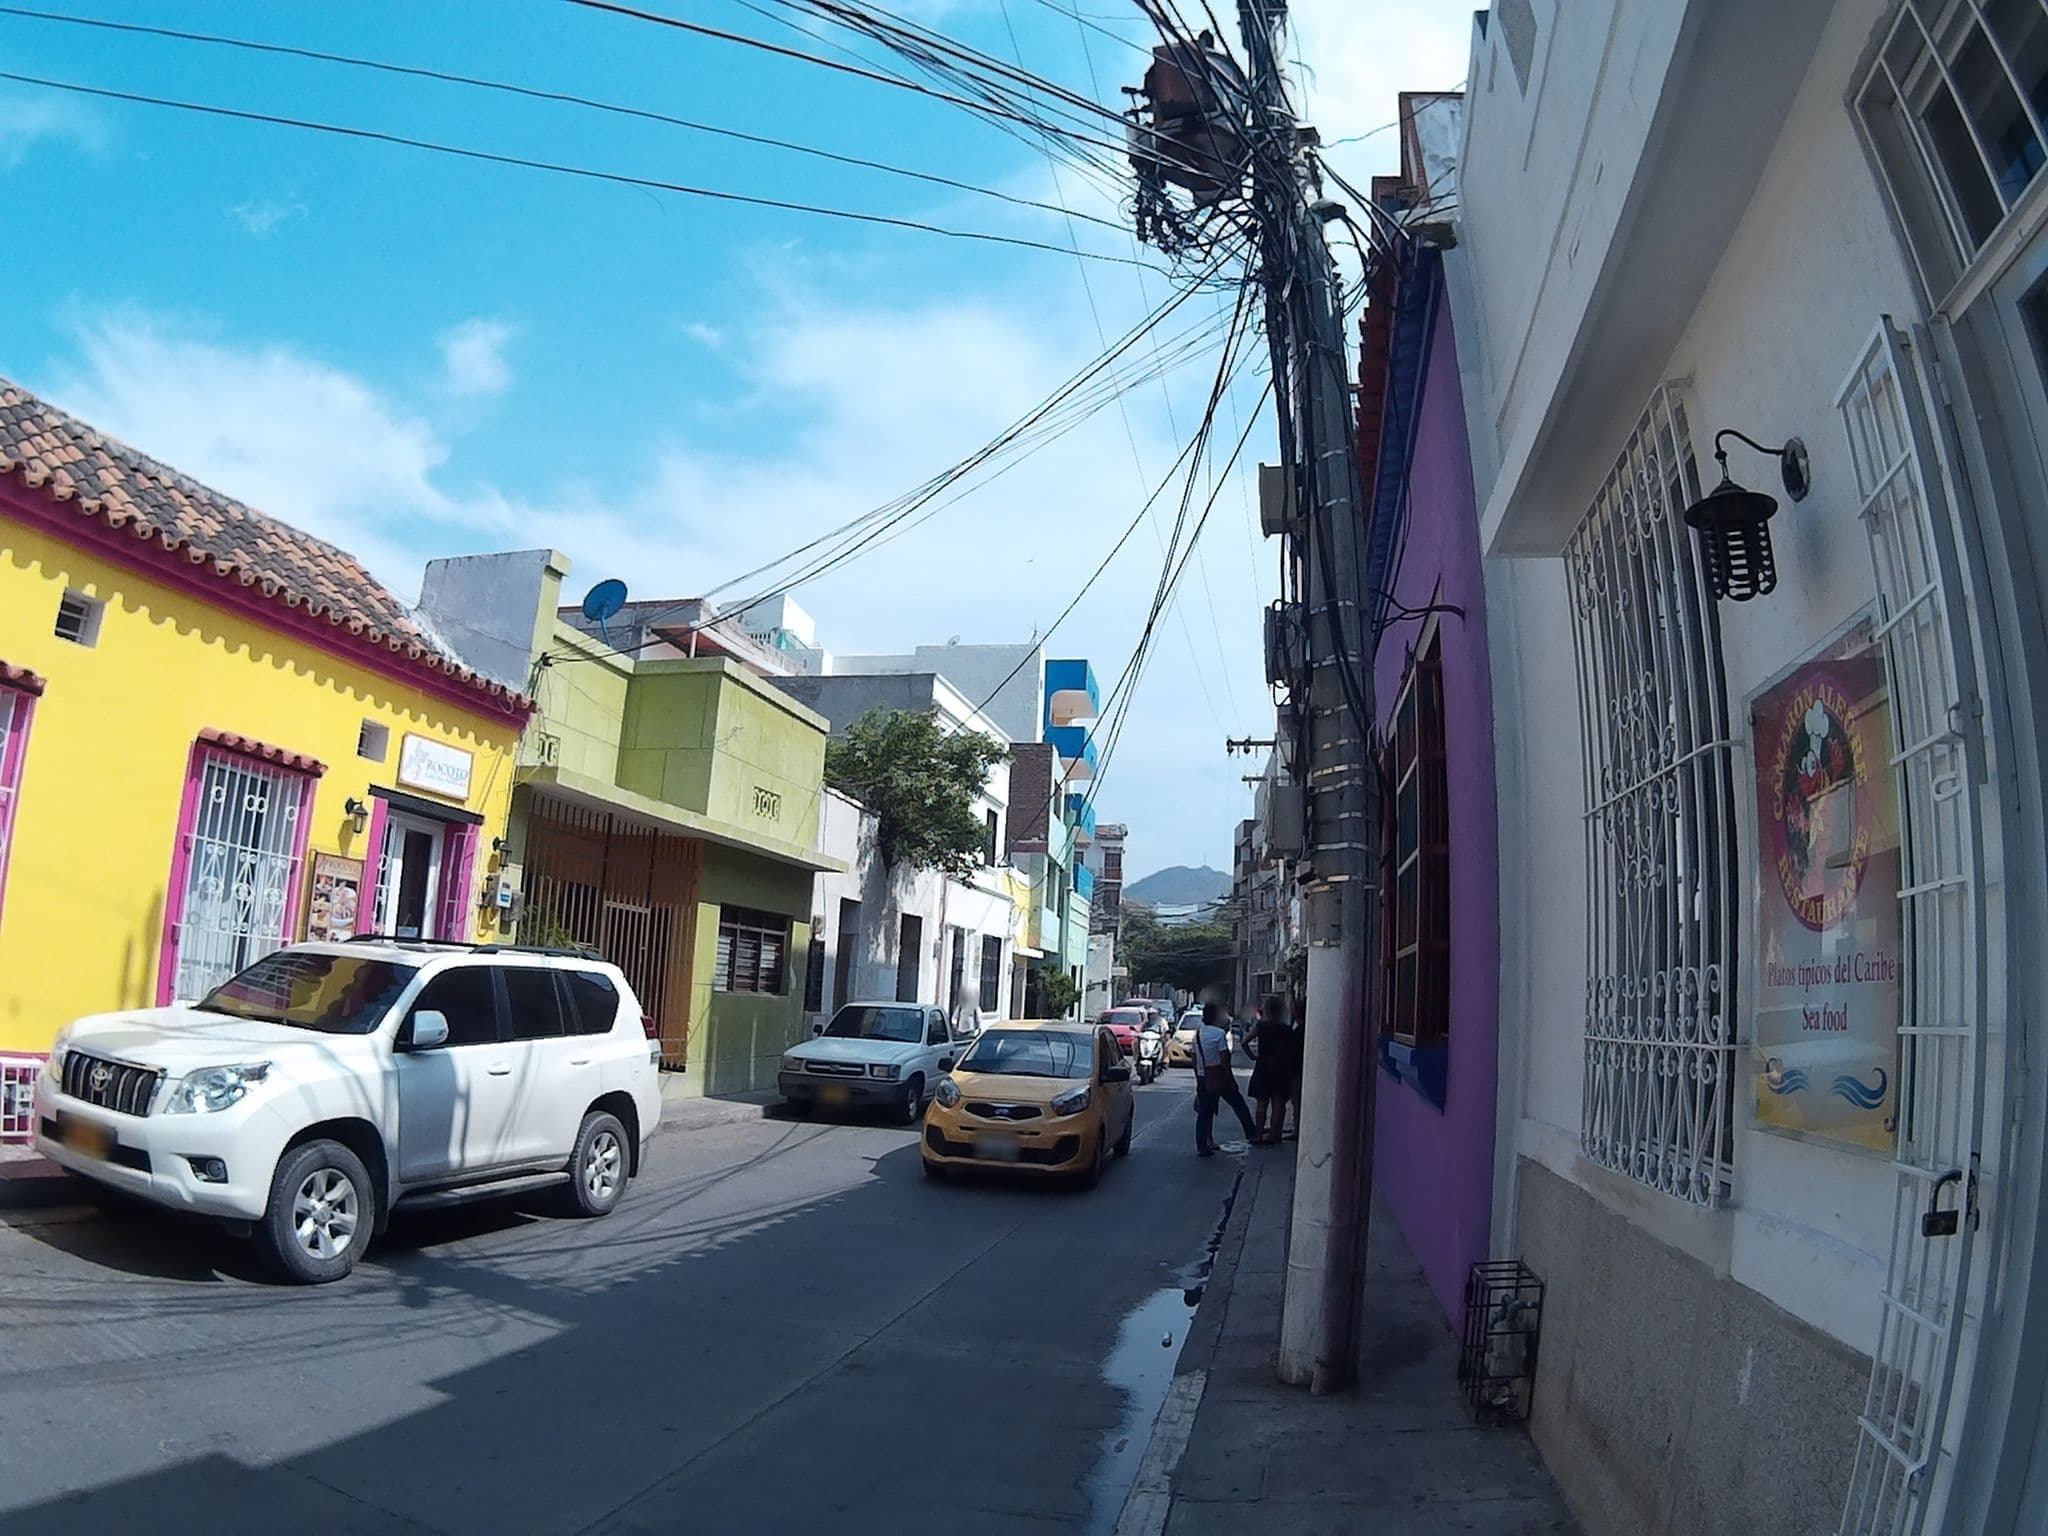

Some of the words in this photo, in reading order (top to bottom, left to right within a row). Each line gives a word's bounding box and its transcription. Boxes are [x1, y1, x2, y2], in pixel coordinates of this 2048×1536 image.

[1820, 683, 1868, 786] ALEGRE
[426, 760, 468, 780] ROCOTO
[1779, 827, 1868, 923] RESTAURANTE
[1768, 963, 1795, 986] Platos
[1834, 955, 1850, 983] del
[1854, 952, 1895, 982] Caribe
[1803, 1003, 1820, 1030] Sea
[1822, 1002, 1847, 1031] food
